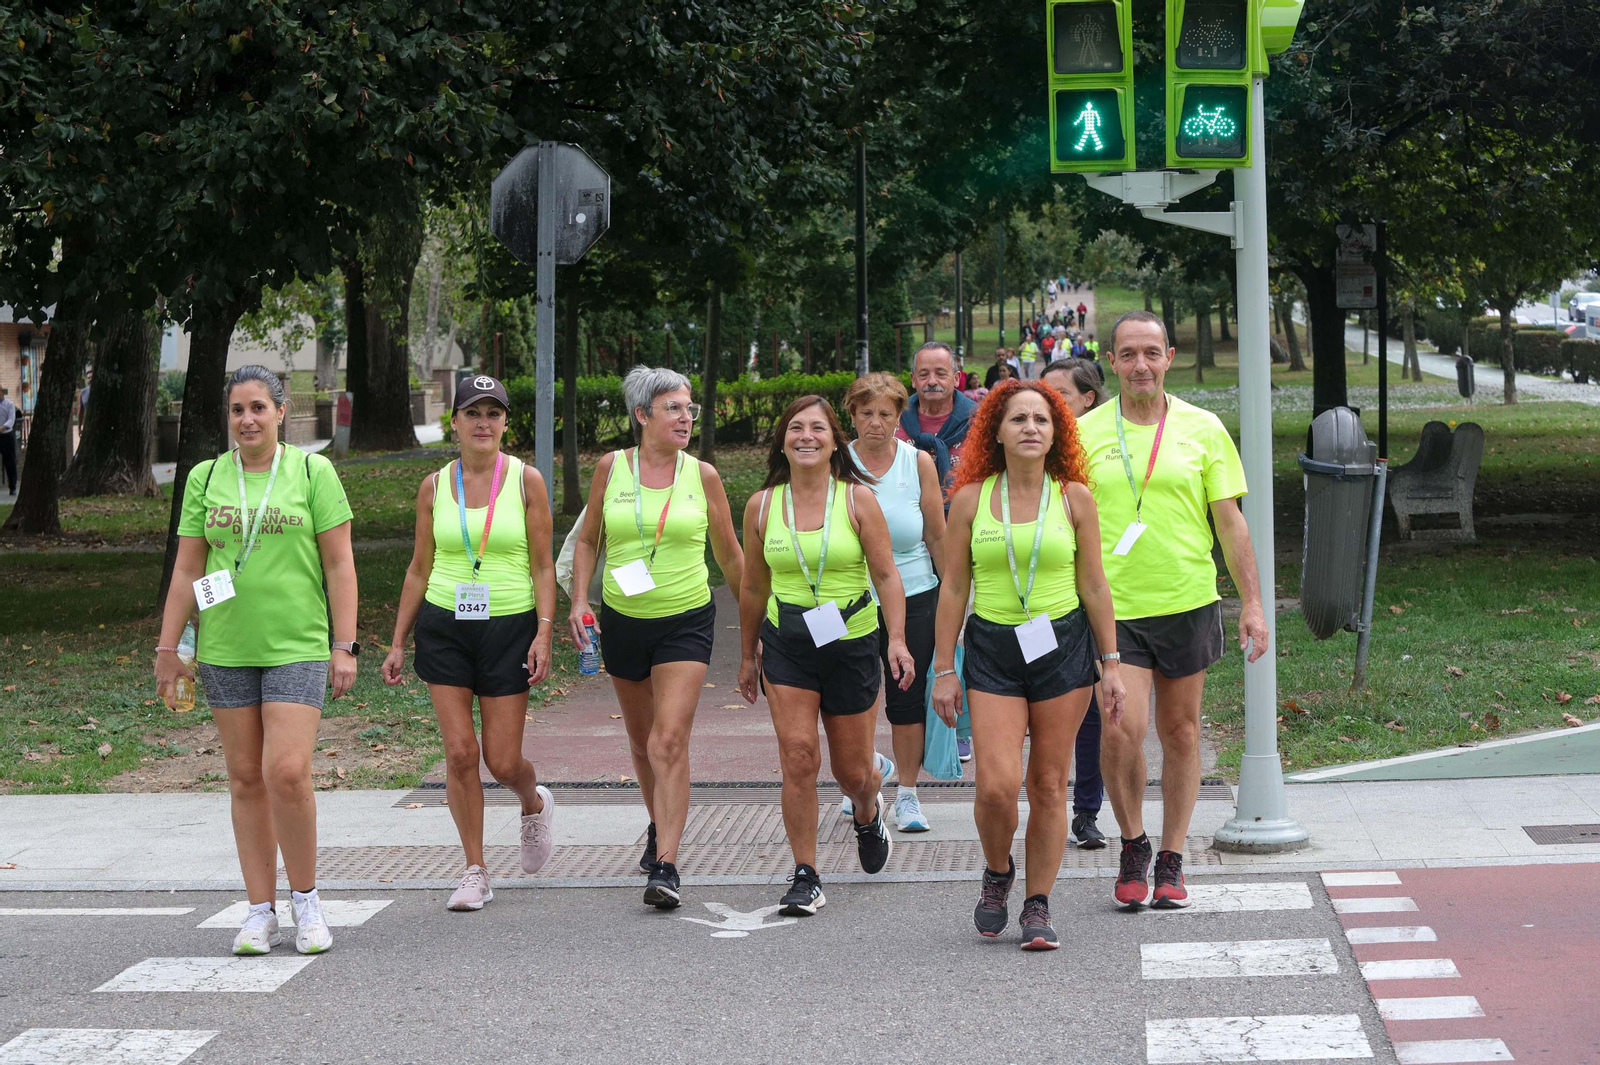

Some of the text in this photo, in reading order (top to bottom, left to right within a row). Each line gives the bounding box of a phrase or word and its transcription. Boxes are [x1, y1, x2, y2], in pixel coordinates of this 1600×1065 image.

[205, 505, 281, 528] 35 marha
[974, 535, 1006, 544] Runners
[201, 578, 215, 605] 0969
[458, 603, 487, 612] 0347
